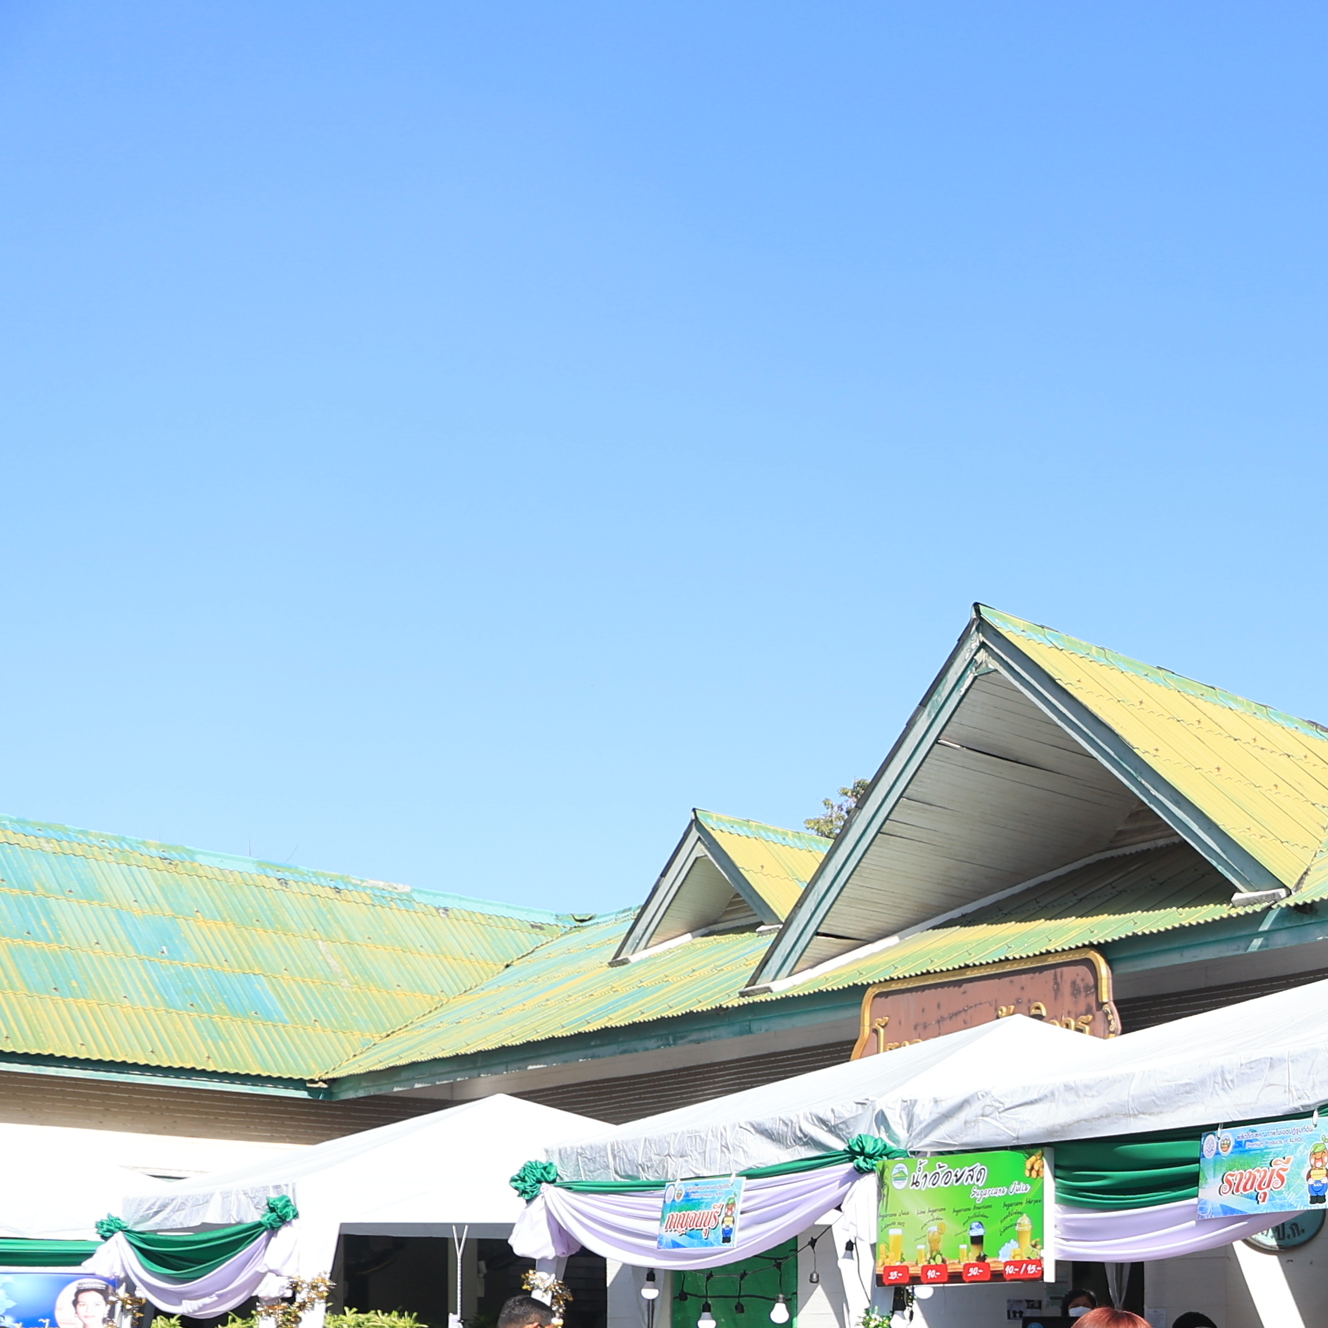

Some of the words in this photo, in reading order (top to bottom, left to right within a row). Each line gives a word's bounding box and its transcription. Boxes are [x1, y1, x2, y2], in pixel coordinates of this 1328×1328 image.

[910, 1159, 987, 1190] น้ำอ้อยสด
[1220, 1156, 1293, 1205] ราชบุรี
[970, 1186, 1007, 1203] Sugarcane
[1008, 1181, 1030, 1196] Juice
